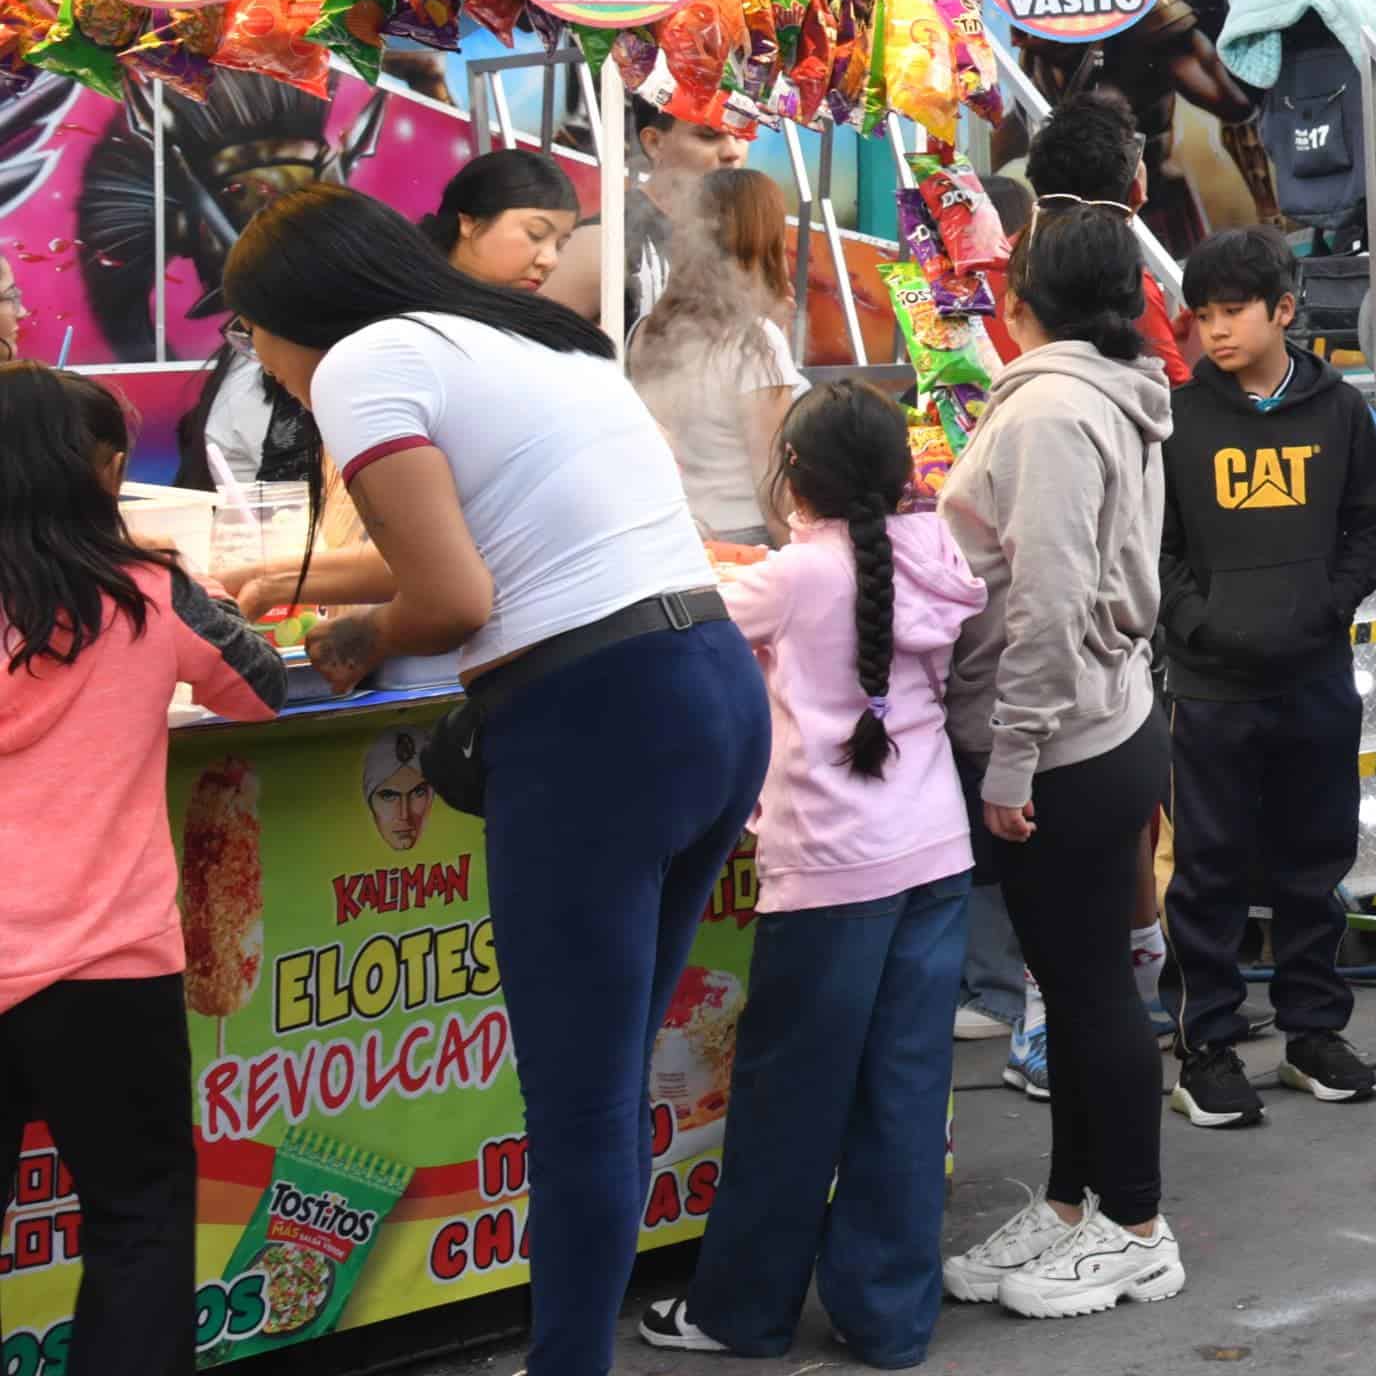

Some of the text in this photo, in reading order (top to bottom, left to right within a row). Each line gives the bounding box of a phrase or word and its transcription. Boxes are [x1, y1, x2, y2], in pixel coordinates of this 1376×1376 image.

[1214, 446, 1313, 509] CAT
[276, 917, 501, 1033] ELOTES
[204, 1011, 508, 1135] REVOLCAD
